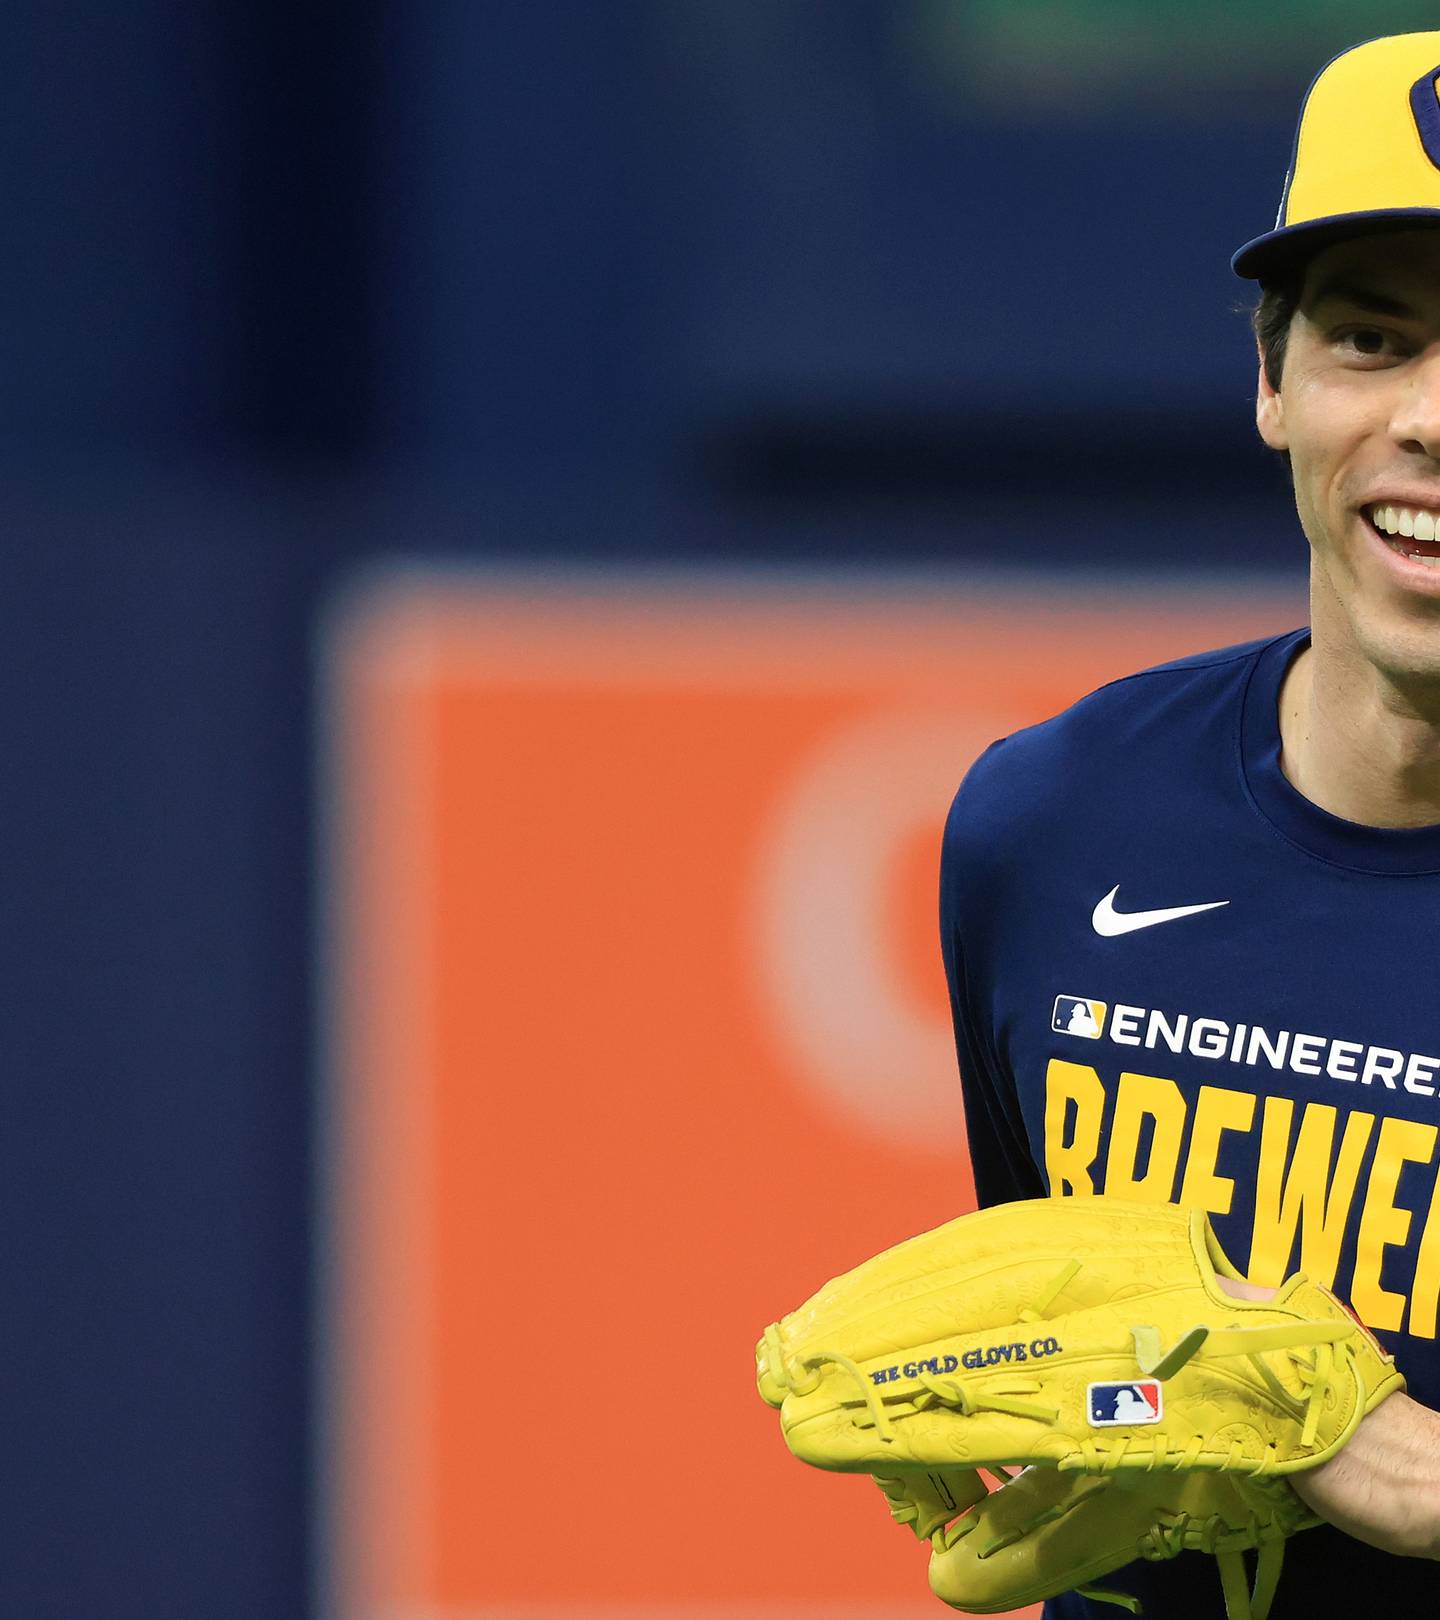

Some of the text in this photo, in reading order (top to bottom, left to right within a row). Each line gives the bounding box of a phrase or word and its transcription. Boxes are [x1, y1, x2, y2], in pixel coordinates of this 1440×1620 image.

[903, 1355, 959, 1379] GOLD
[961, 1342, 1028, 1368] GLOVE
[1029, 1337, 1063, 1358] CO.
